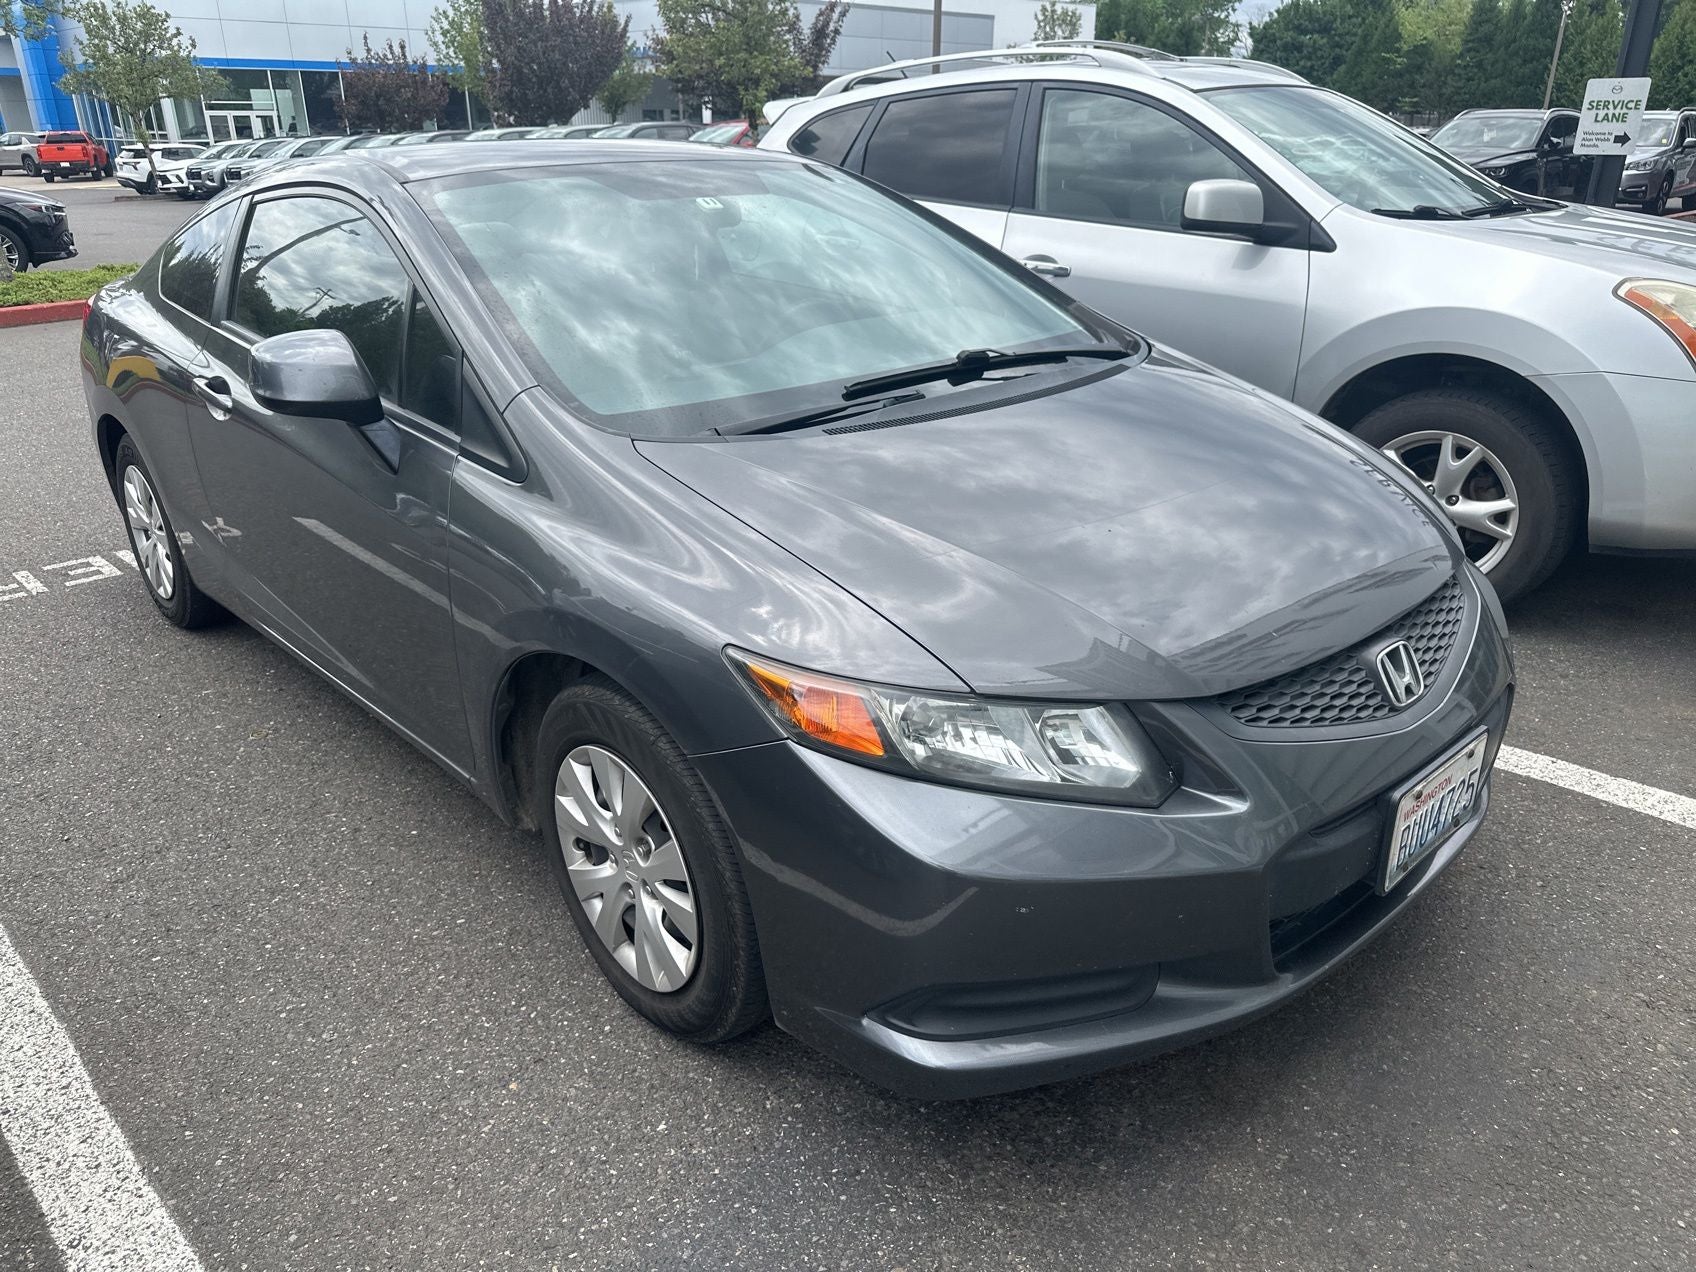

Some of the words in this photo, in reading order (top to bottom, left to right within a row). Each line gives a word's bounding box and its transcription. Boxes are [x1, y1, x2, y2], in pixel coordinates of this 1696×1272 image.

[1587, 99, 1642, 111] SERVICE
[1594, 112, 1628, 123] LANE
[1403, 774, 1453, 822] WASHINGTON
[1396, 768, 1478, 869] BUU4725
